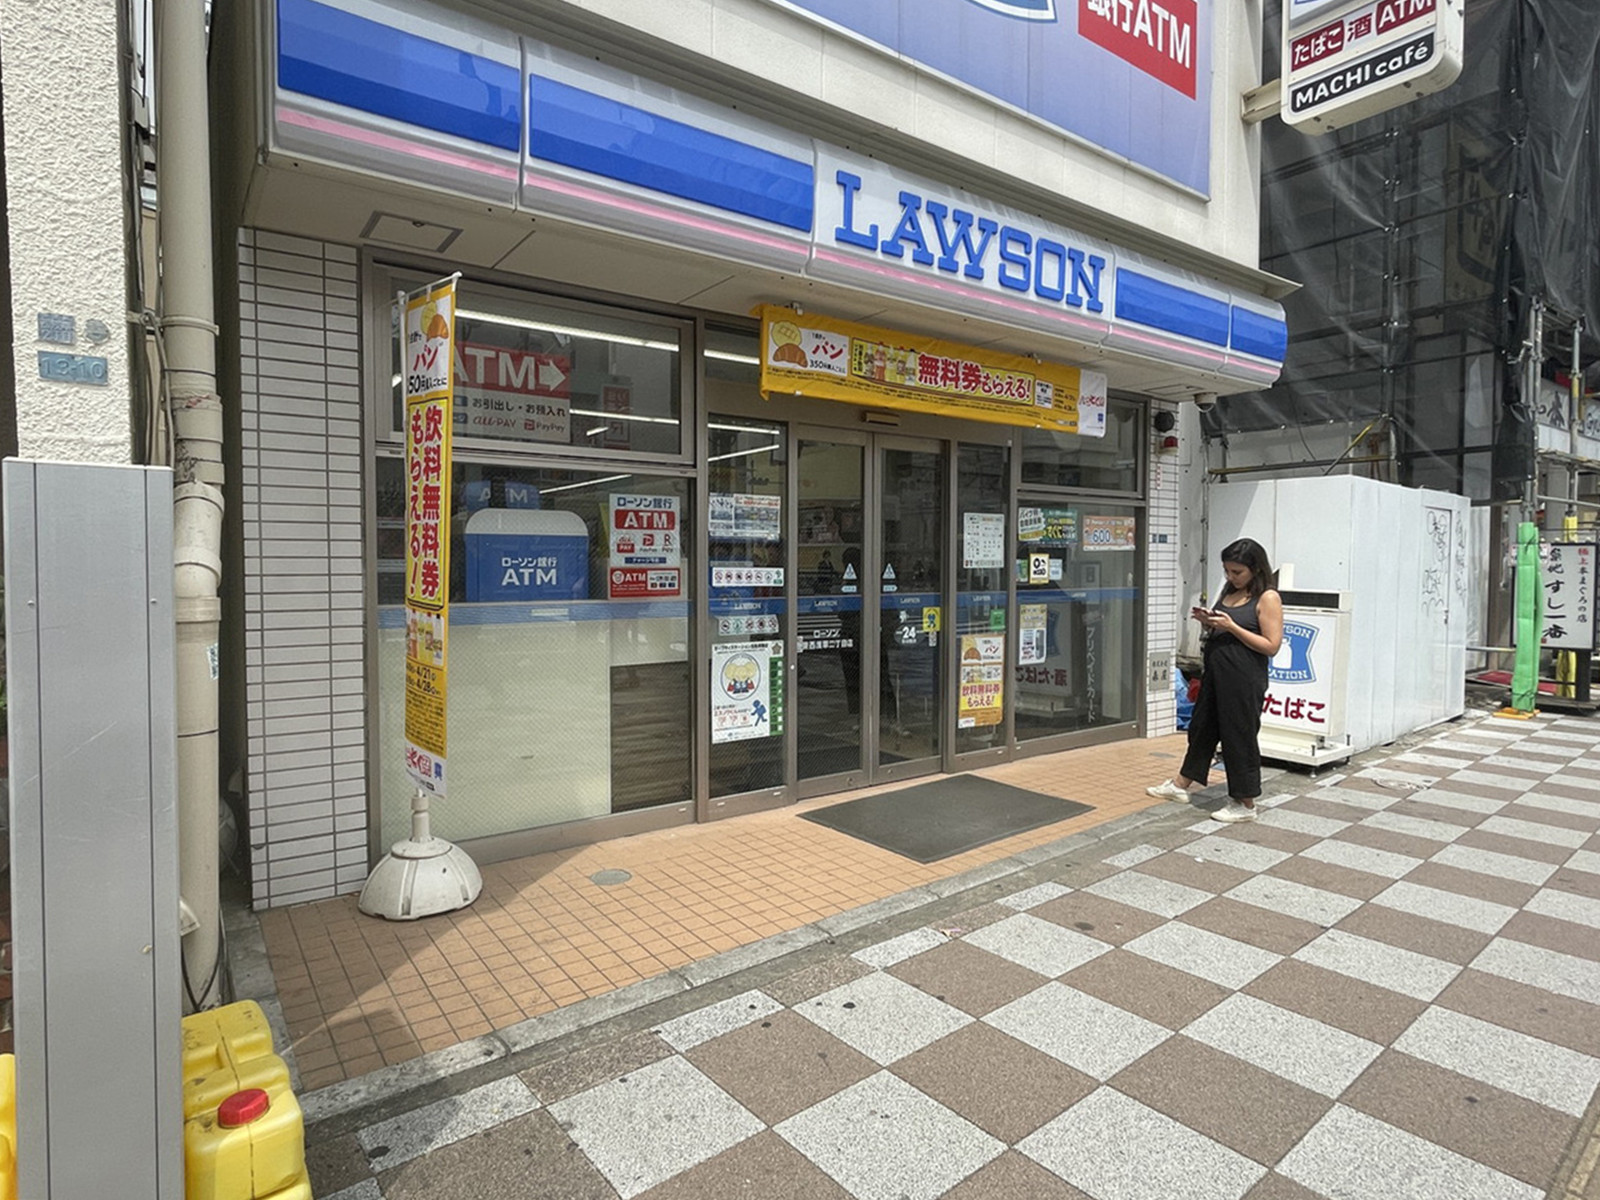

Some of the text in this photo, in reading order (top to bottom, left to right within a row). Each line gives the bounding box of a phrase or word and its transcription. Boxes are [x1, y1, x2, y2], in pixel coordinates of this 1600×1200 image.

[1294, 0, 1432, 65] たばこ 酒 ATM
[1296, 42, 1428, 108] MACHI café
[835, 170, 1105, 313] LAWSON
[413, 344, 438, 371] パン
[812, 341, 843, 360] パン
[421, 404, 443, 597] 飲料無料券
[617, 497, 673, 509] ローソン銀行
[624, 511, 668, 528] ATM
[501, 557, 557, 568] ローソン銀行
[501, 568, 557, 586] ATM
[625, 573, 646, 582] ATM
[902, 626, 916, 638] 24
[1283, 625, 1311, 638] SON
[1086, 627, 1096, 723] プリペイドカード
[1269, 670, 1308, 679] ATION
[1262, 694, 1325, 723] たばこ
